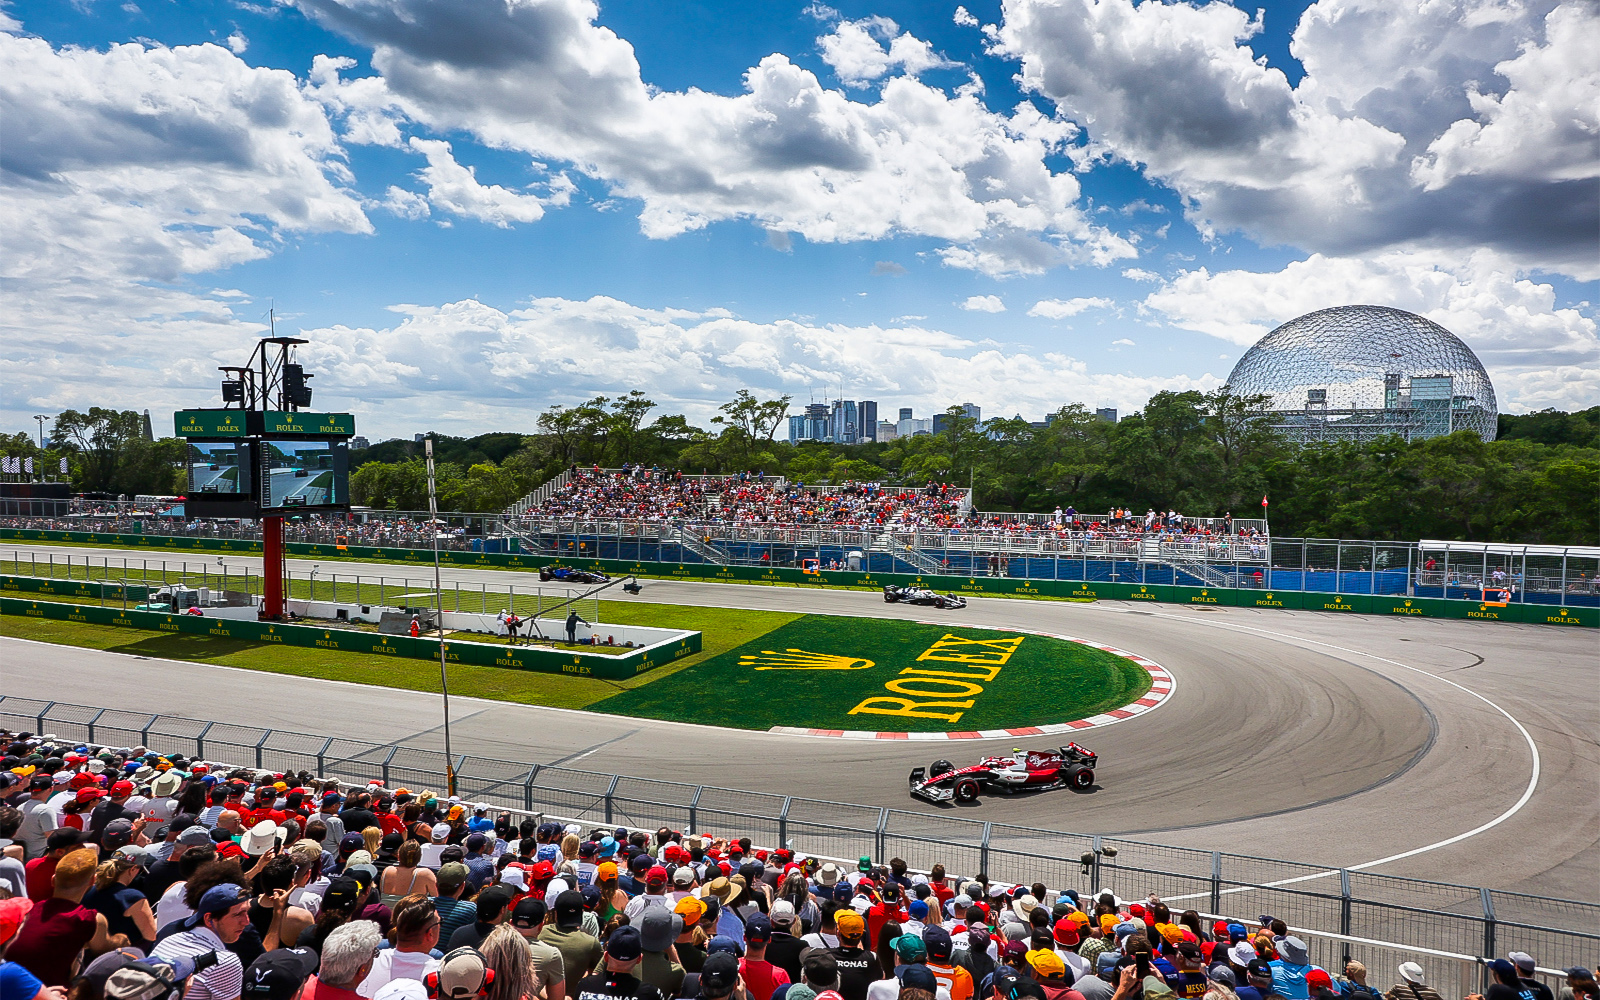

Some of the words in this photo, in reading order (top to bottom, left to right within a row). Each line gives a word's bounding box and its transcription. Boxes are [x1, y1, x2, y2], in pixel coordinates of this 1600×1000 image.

[1468, 611, 1498, 619] ROLEX
[1547, 616, 1580, 624] ROLEX
[209, 628, 230, 636] ROLEX
[316, 640, 339, 648] ROLEX
[372, 645, 396, 654] ROLEX
[675, 647, 691, 657] ROLEX
[496, 658, 523, 667] ROLEX
[636, 660, 654, 672] ROLEX
[562, 664, 591, 674] ROLEX
[847, 633, 1025, 723] ROLEX
[1186, 983, 1205, 993] MESSI
